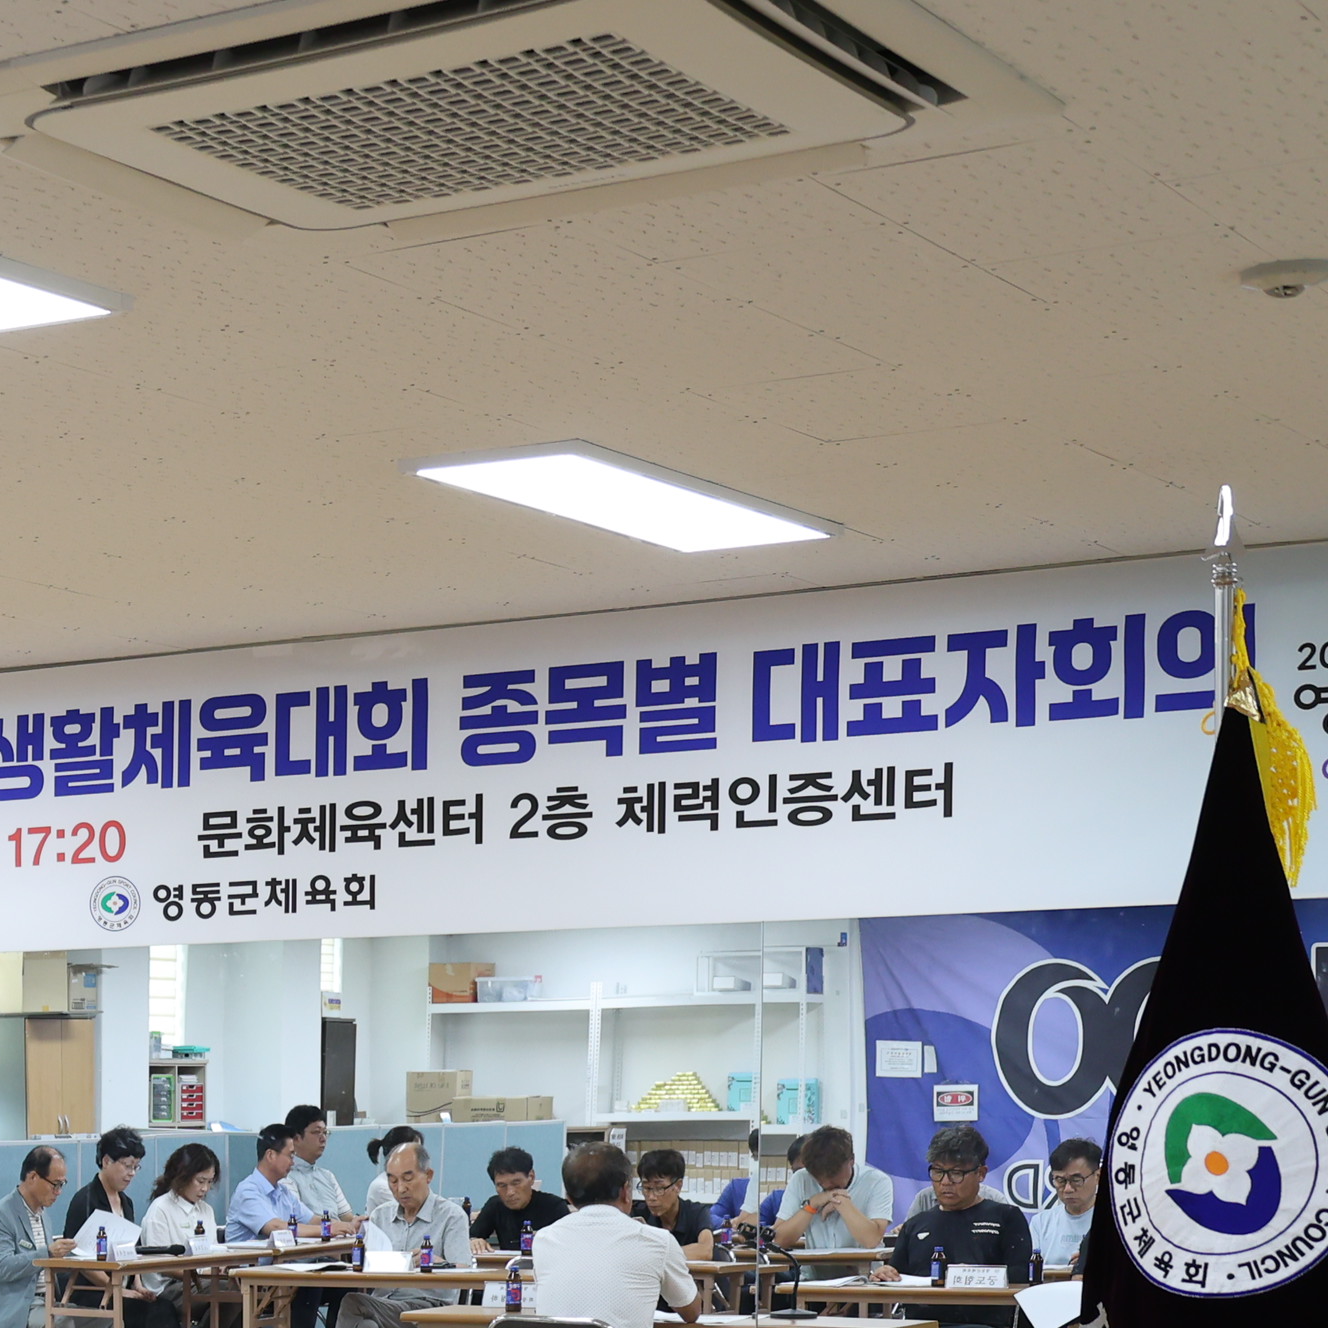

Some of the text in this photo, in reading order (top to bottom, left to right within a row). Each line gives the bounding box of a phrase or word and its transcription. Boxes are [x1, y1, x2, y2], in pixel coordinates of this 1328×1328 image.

[459, 651, 718, 769] 종목별
[752, 603, 1256, 743] 대표자회의
[7, 820, 128, 868] 17:20
[197, 762, 955, 859] 문화체육센터 2층 체력인증센터
[153, 873, 377, 922] 영동군체육회
[1142, 1042, 1328, 1116] YEONGDONG-GUN
[1114, 1126, 1208, 1288] 영동군체육회
[1238, 1208, 1328, 1281] COUNCIL
